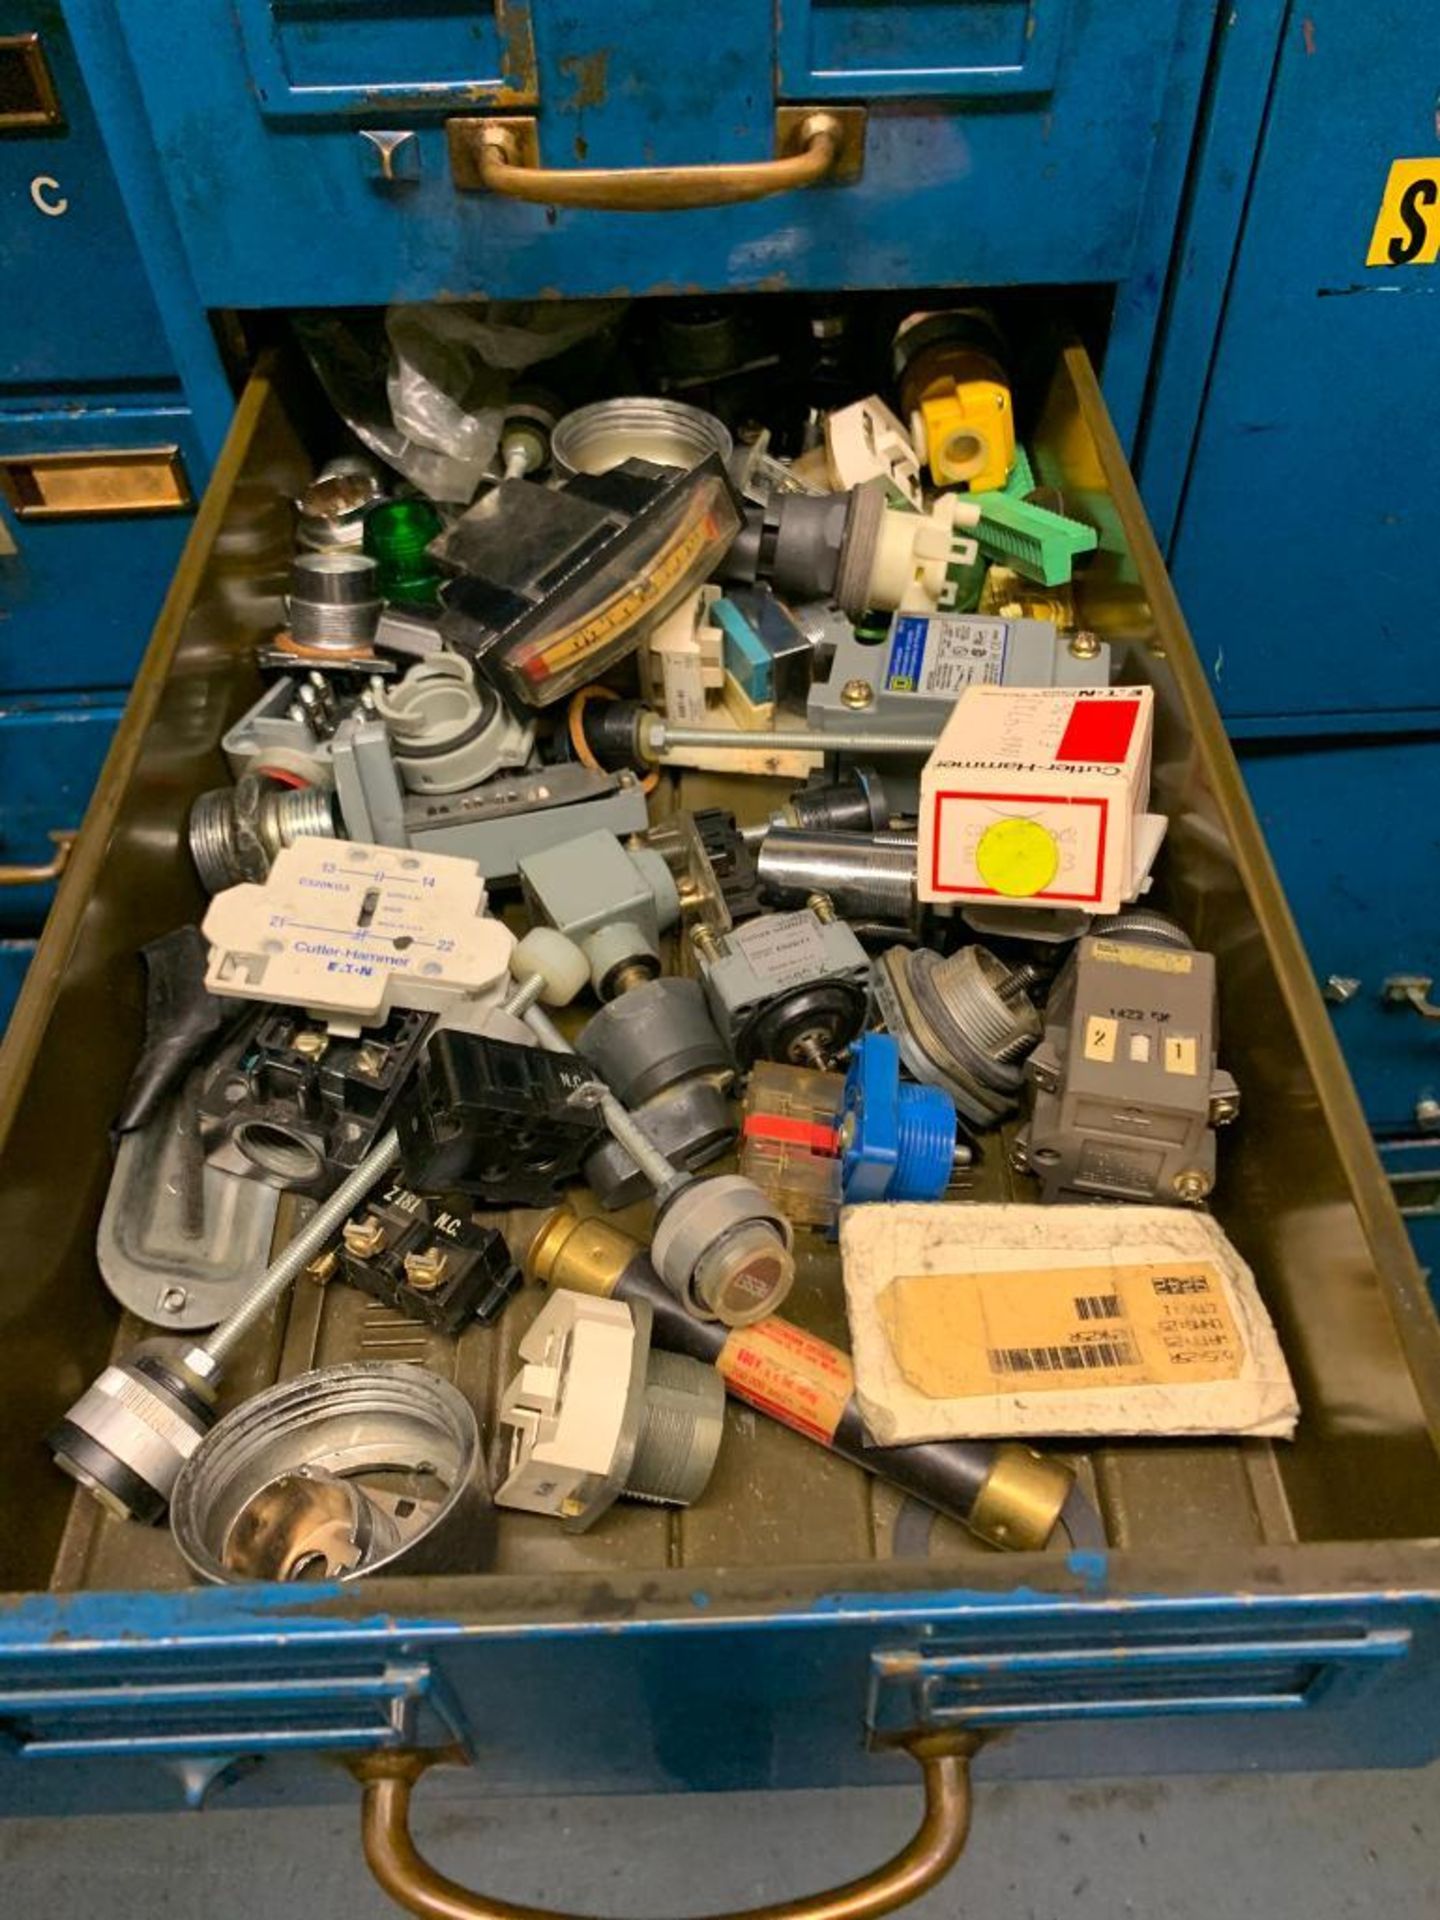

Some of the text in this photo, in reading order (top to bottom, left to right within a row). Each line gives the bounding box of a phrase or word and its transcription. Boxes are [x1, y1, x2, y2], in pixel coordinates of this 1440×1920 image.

[31, 177, 68, 216] C
[1388, 179, 1438, 267] S
[422, 876, 436, 888] 14
[269, 915, 455, 952] 21 22
